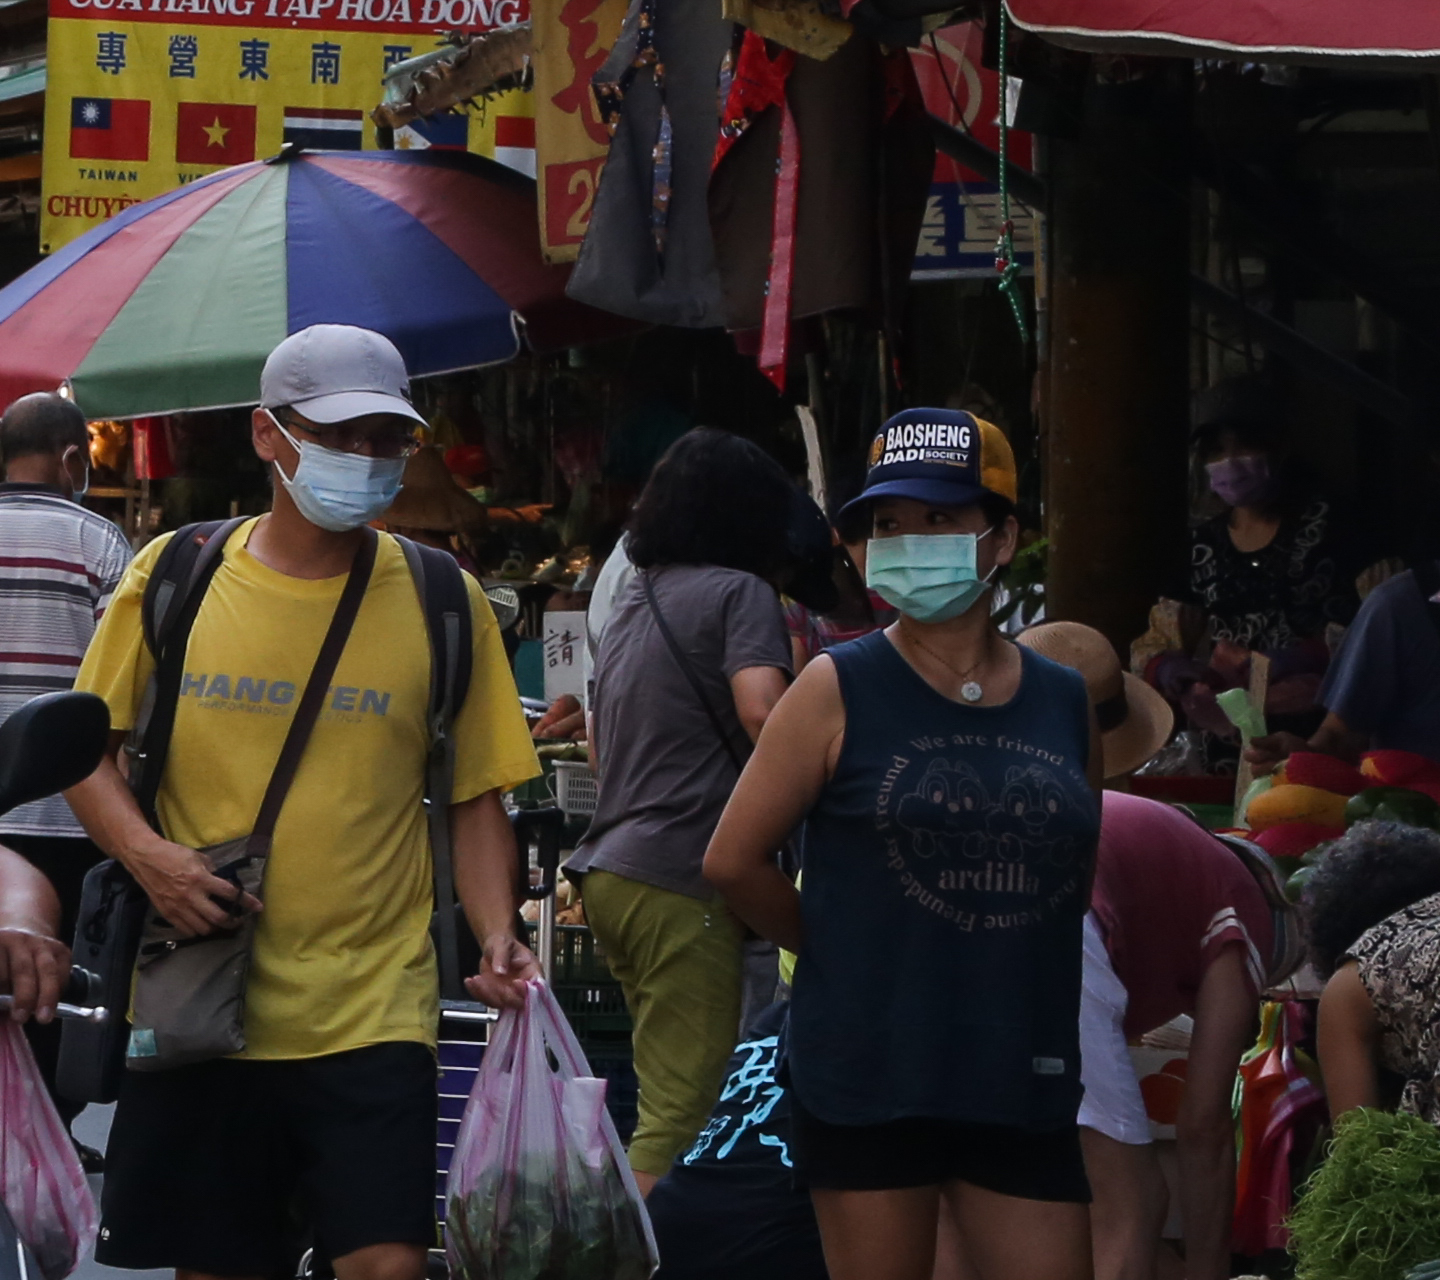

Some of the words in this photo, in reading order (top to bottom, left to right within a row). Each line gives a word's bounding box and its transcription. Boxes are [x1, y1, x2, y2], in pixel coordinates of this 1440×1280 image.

[78, 168, 138, 182] TAIWAN
[47, 193, 143, 219] CHUYÊ
[885, 423, 971, 451] BAOSHENG
[882, 448, 926, 466] DADI
[925, 450, 969, 462] SOCIETY
[180, 672, 296, 705] HANG
[328, 684, 392, 717] EN
[909, 735, 947, 752] We
[952, 733, 988, 746] are
[937, 861, 1040, 894] ardilla
